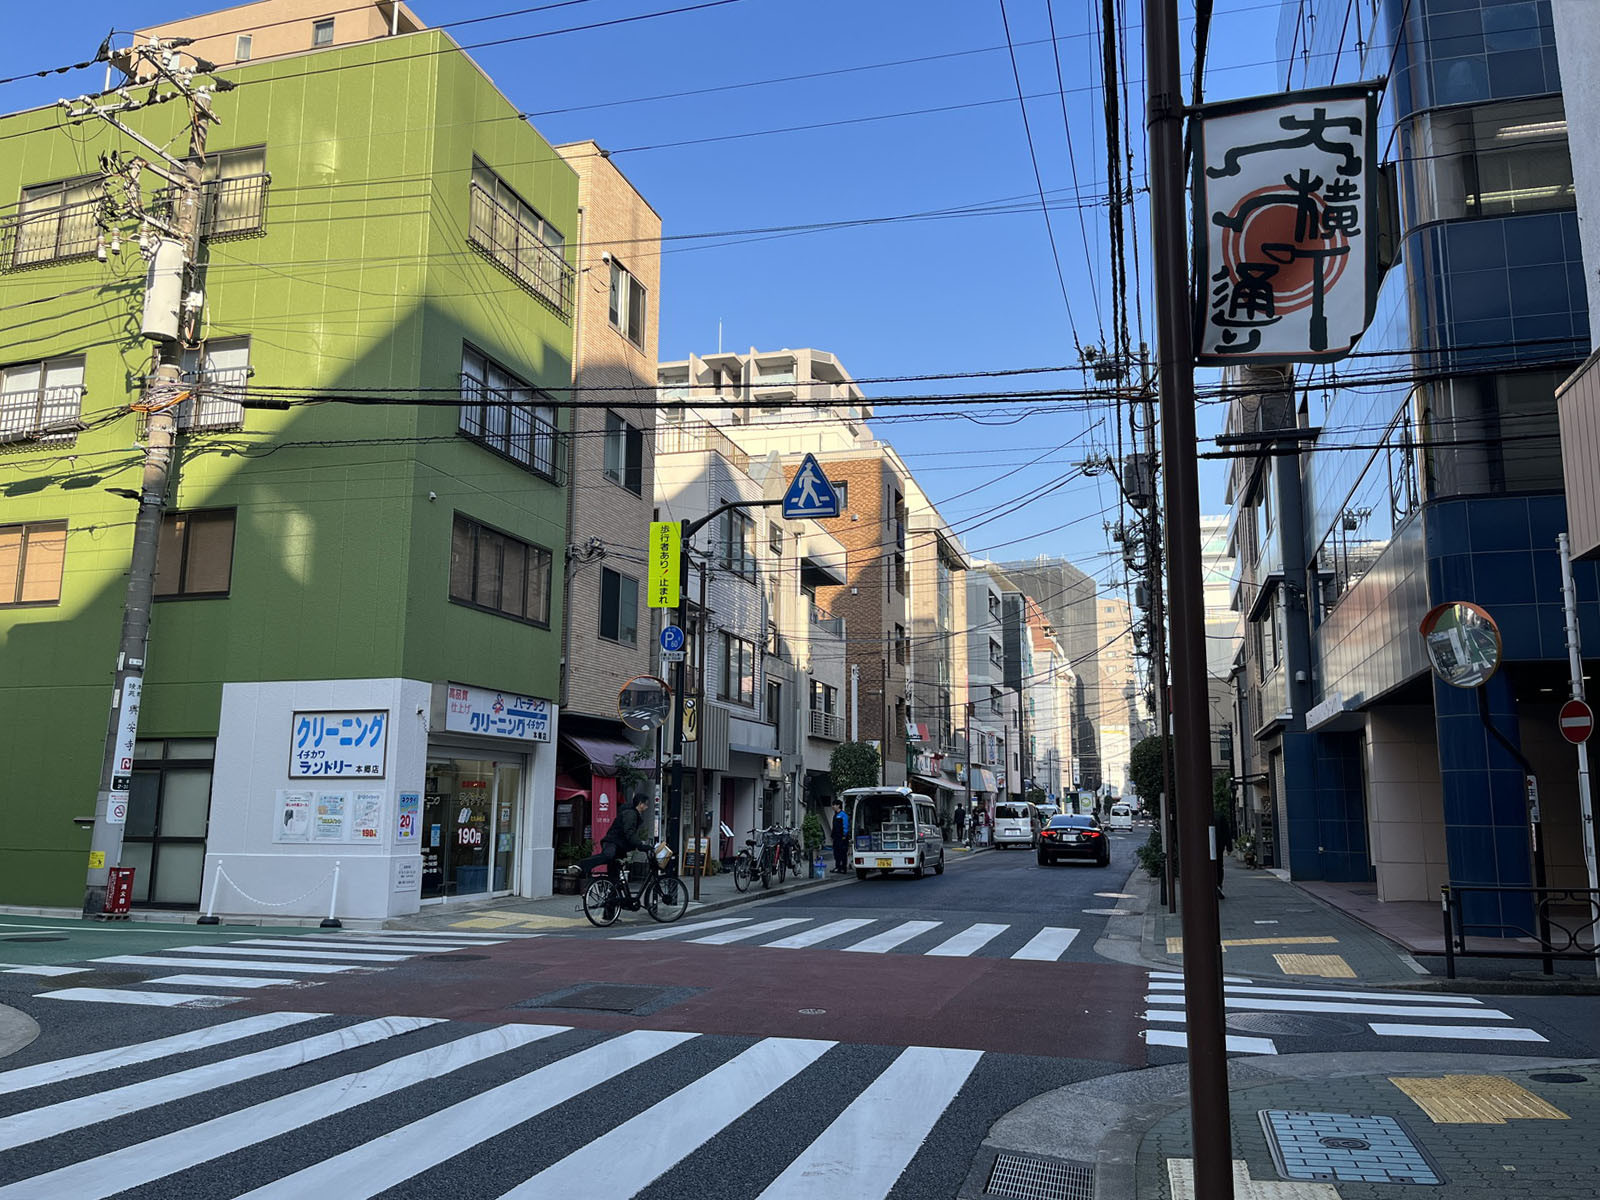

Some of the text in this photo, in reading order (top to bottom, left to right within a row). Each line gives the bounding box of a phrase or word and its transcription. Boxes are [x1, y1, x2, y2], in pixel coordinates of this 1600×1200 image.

[664, 632, 674, 648] P
[451, 702, 472, 715] 仕上げ
[297, 714, 385, 749] クリーニング
[470, 712, 526, 737] クリーニング
[526, 719, 545, 731] イチカワ
[297, 750, 326, 760] イチカワ
[300, 760, 352, 775] ランドリー
[355, 765, 379, 774] 本郷店
[400, 814, 411, 828] 20
[458, 827, 482, 845] 190円
